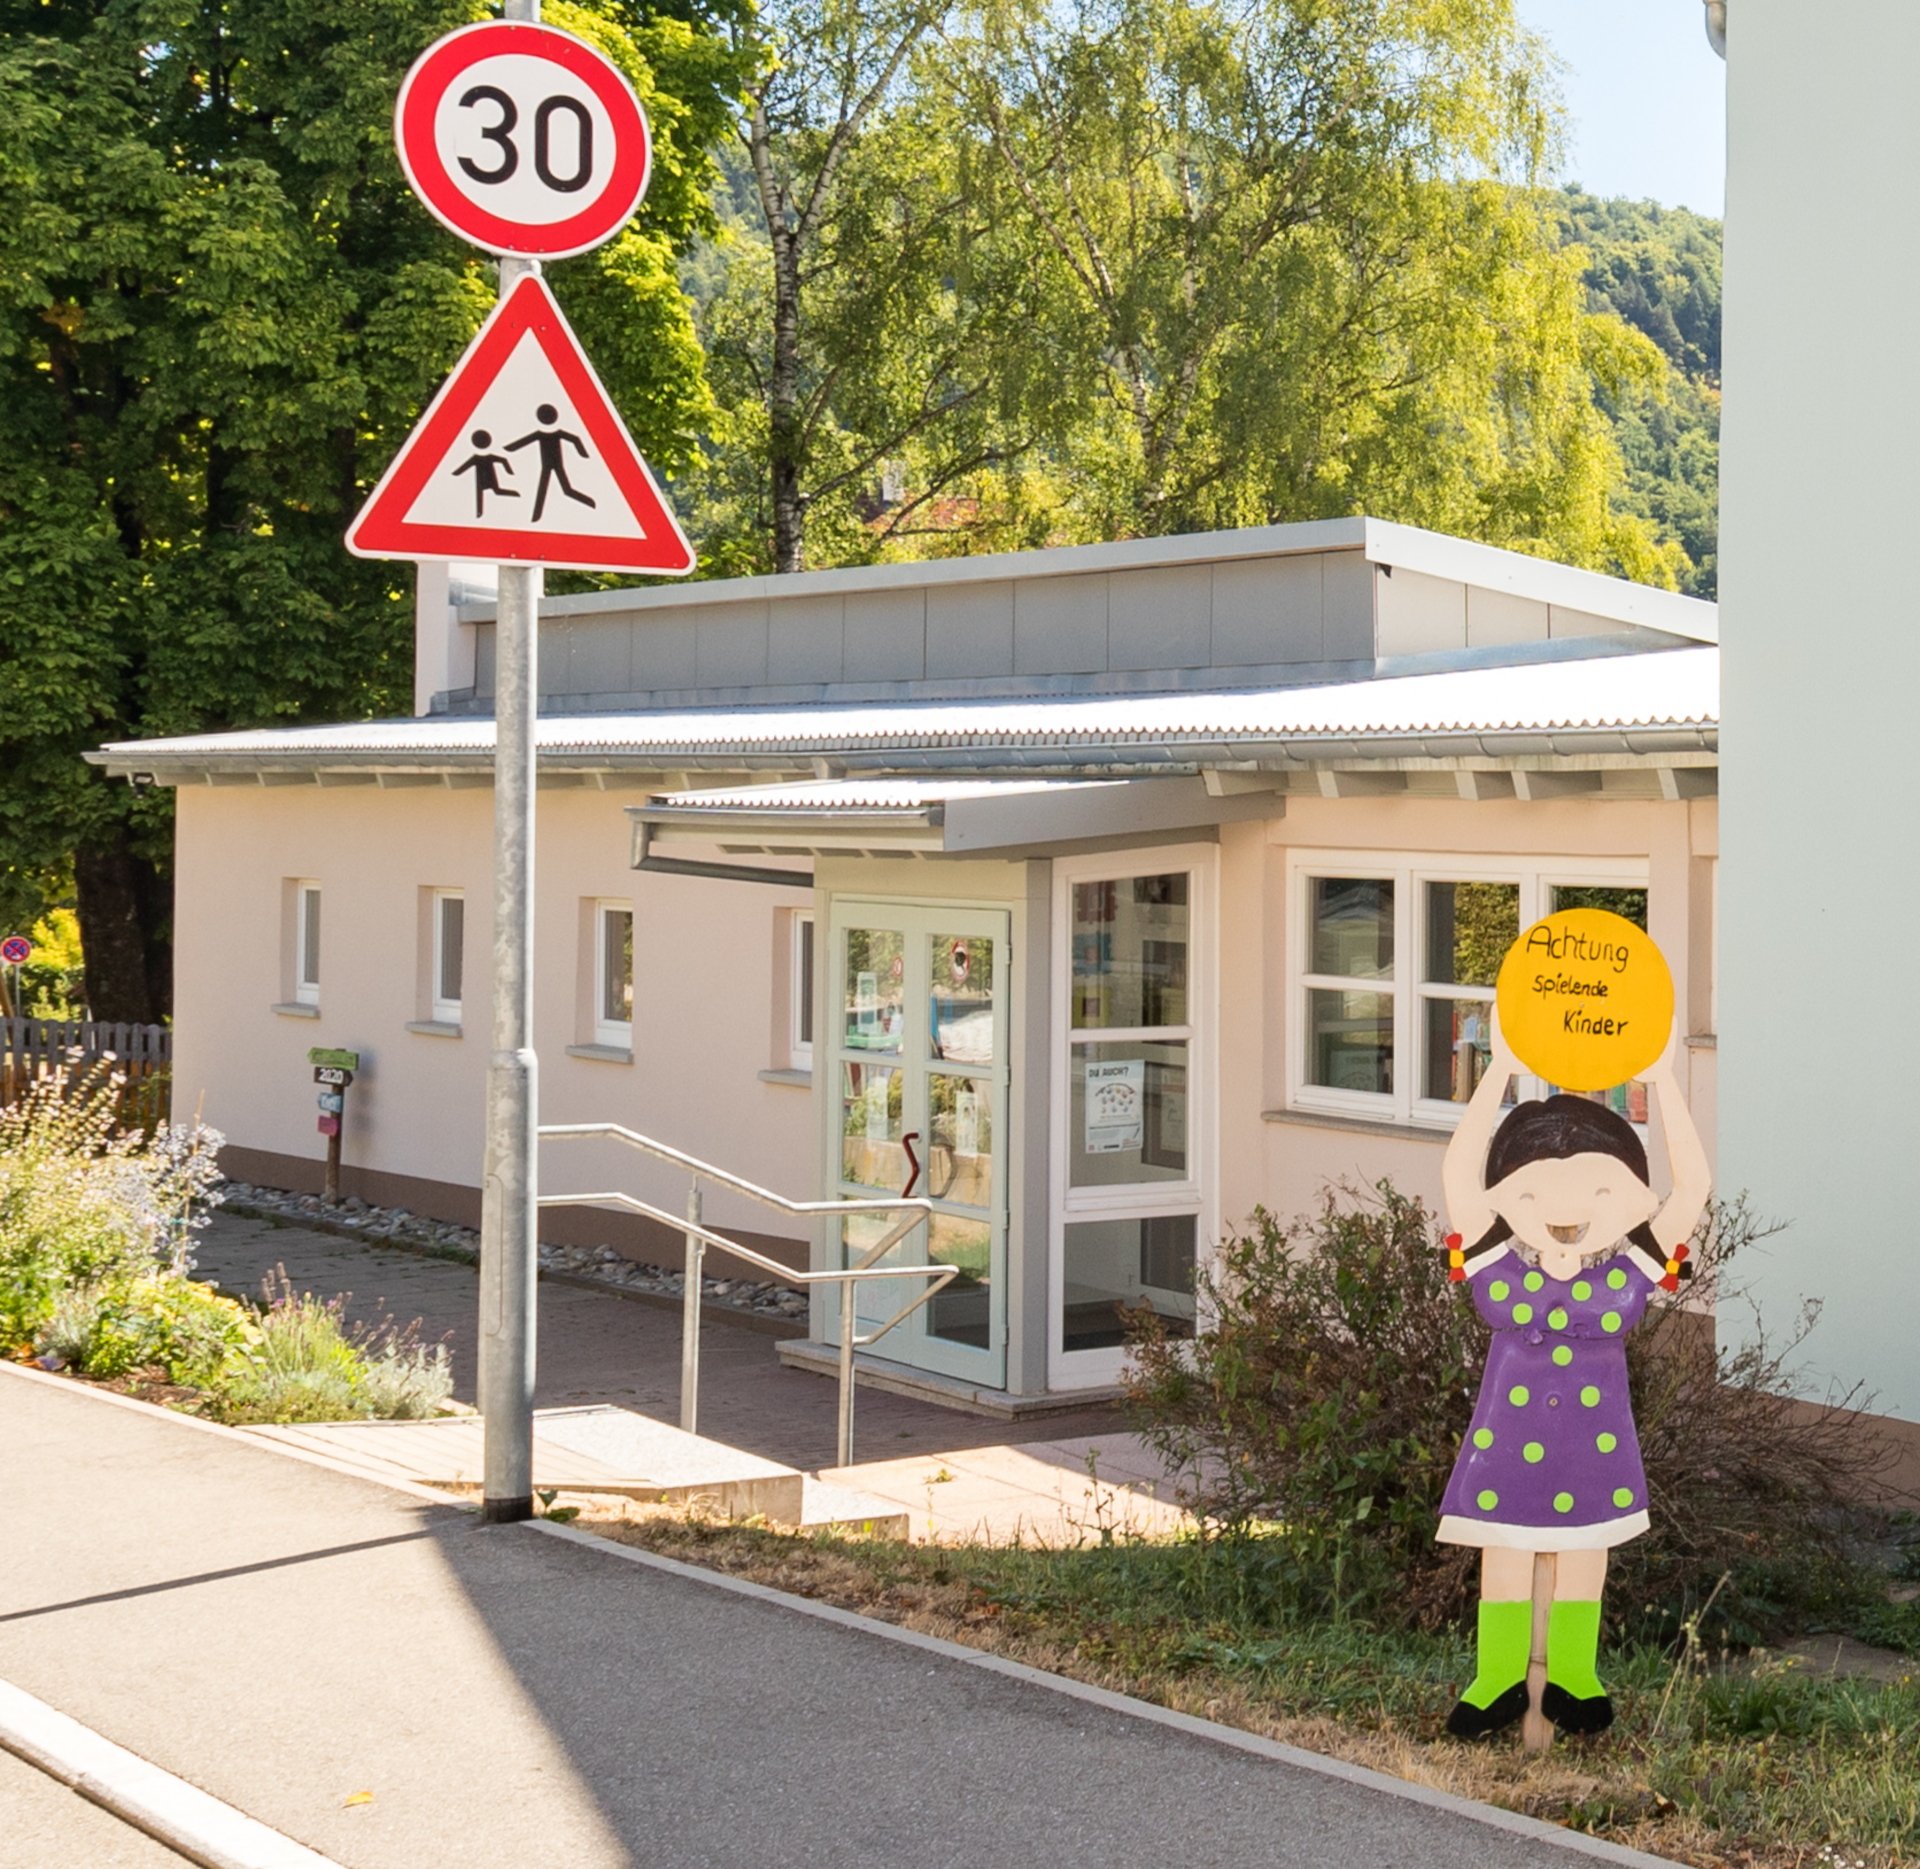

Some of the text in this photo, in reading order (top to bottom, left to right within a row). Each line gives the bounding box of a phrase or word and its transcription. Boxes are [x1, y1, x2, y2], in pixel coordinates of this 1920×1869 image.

[457, 85, 593, 193] 30
[1527, 925, 1629, 973] Achtung
[1564, 1010, 1629, 1036] Kinder
